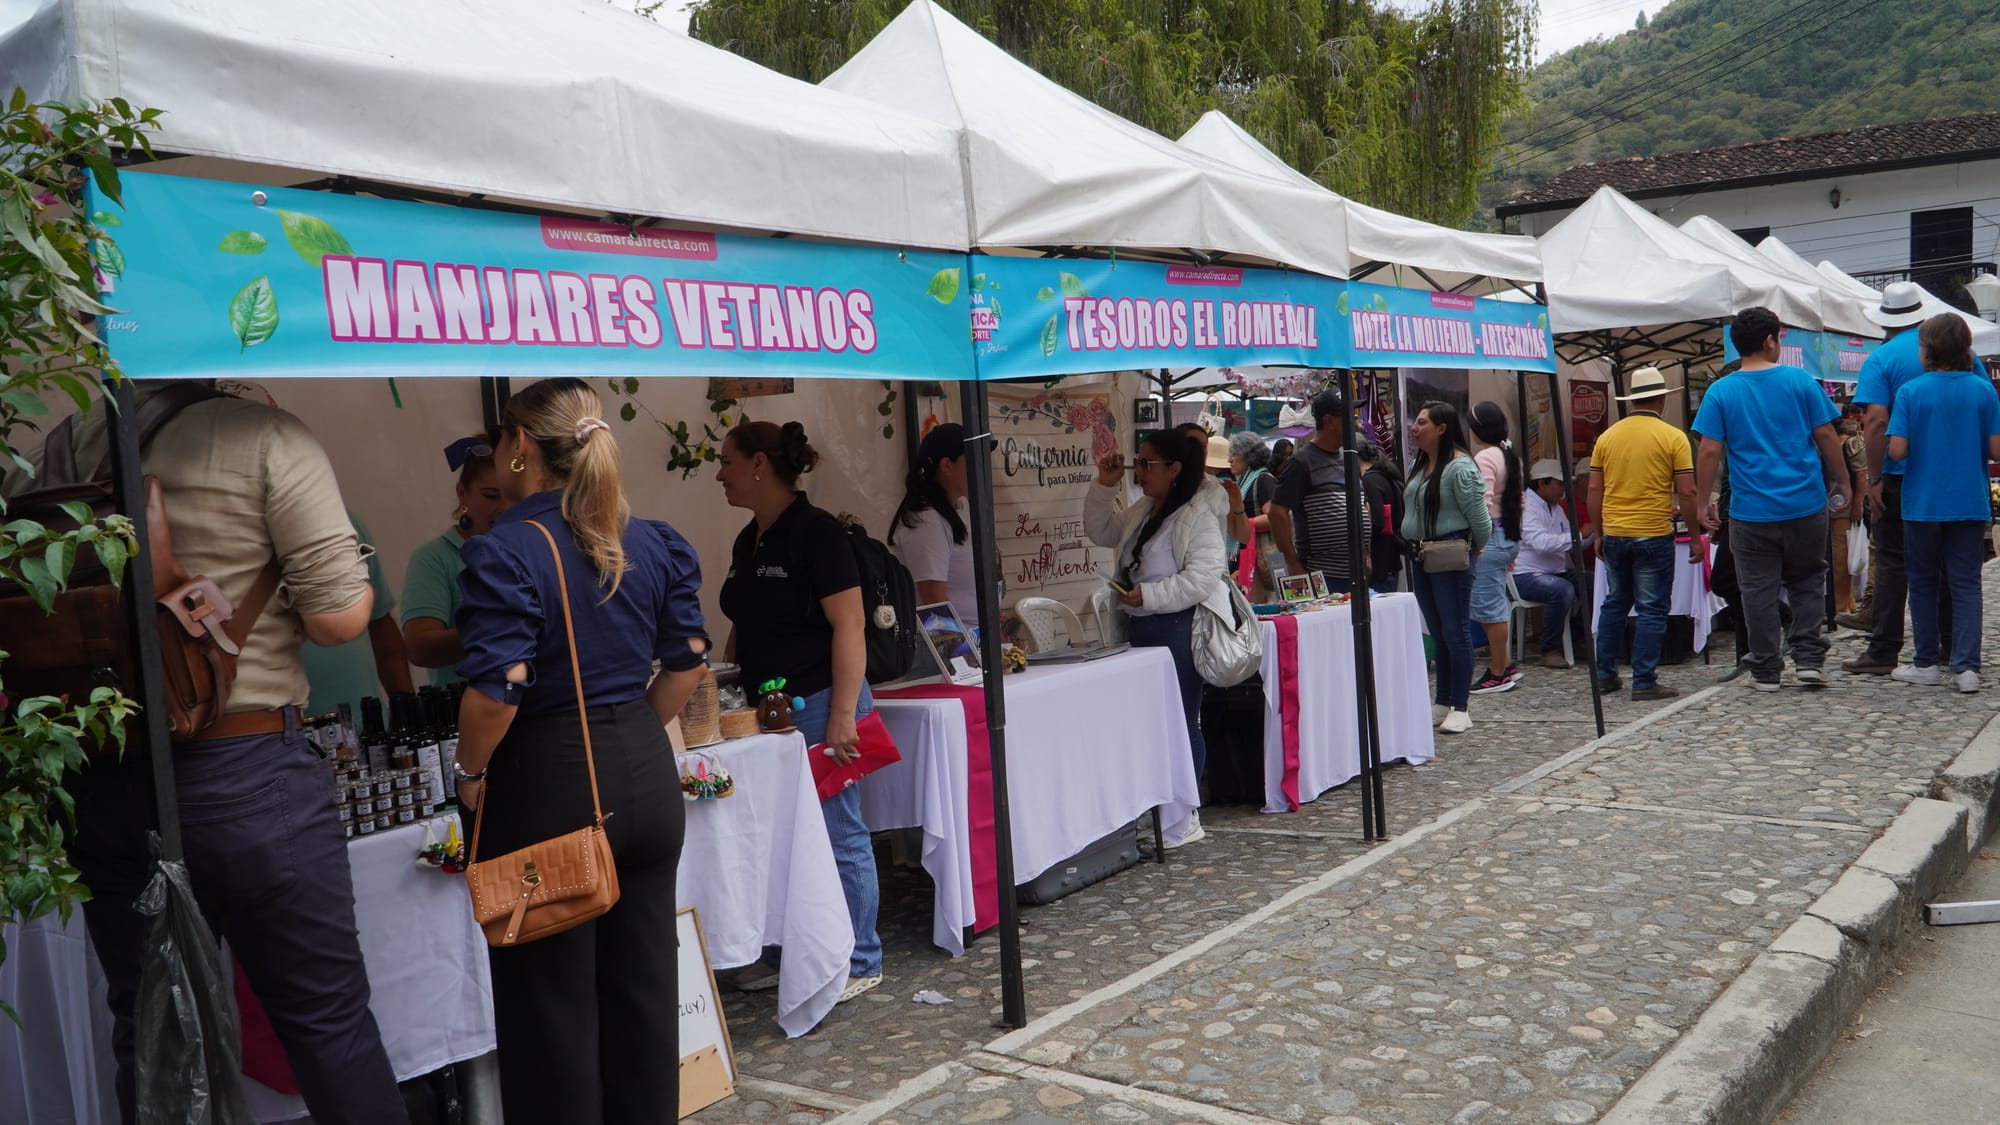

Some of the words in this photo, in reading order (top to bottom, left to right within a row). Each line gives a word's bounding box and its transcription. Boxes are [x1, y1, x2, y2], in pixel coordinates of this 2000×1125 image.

[548, 228, 710, 253] www.camaradirecta.com
[1169, 271, 1239, 281] www.camaradirecta.com
[323, 255, 662, 349] MANJARES
[663, 279, 877, 354] VETANOS
[1065, 296, 1188, 351] TESOROS
[1193, 299, 1220, 349] EL
[1352, 310, 1395, 351] HOTEL
[1394, 313, 1413, 352] LA
[1412, 315, 1475, 356] MOLIENDA
[1481, 320, 1548, 359] ARTESANÍAS
[1000, 437, 1089, 487] California
[1047, 475, 1067, 488] para
[1016, 512, 1041, 537] La
